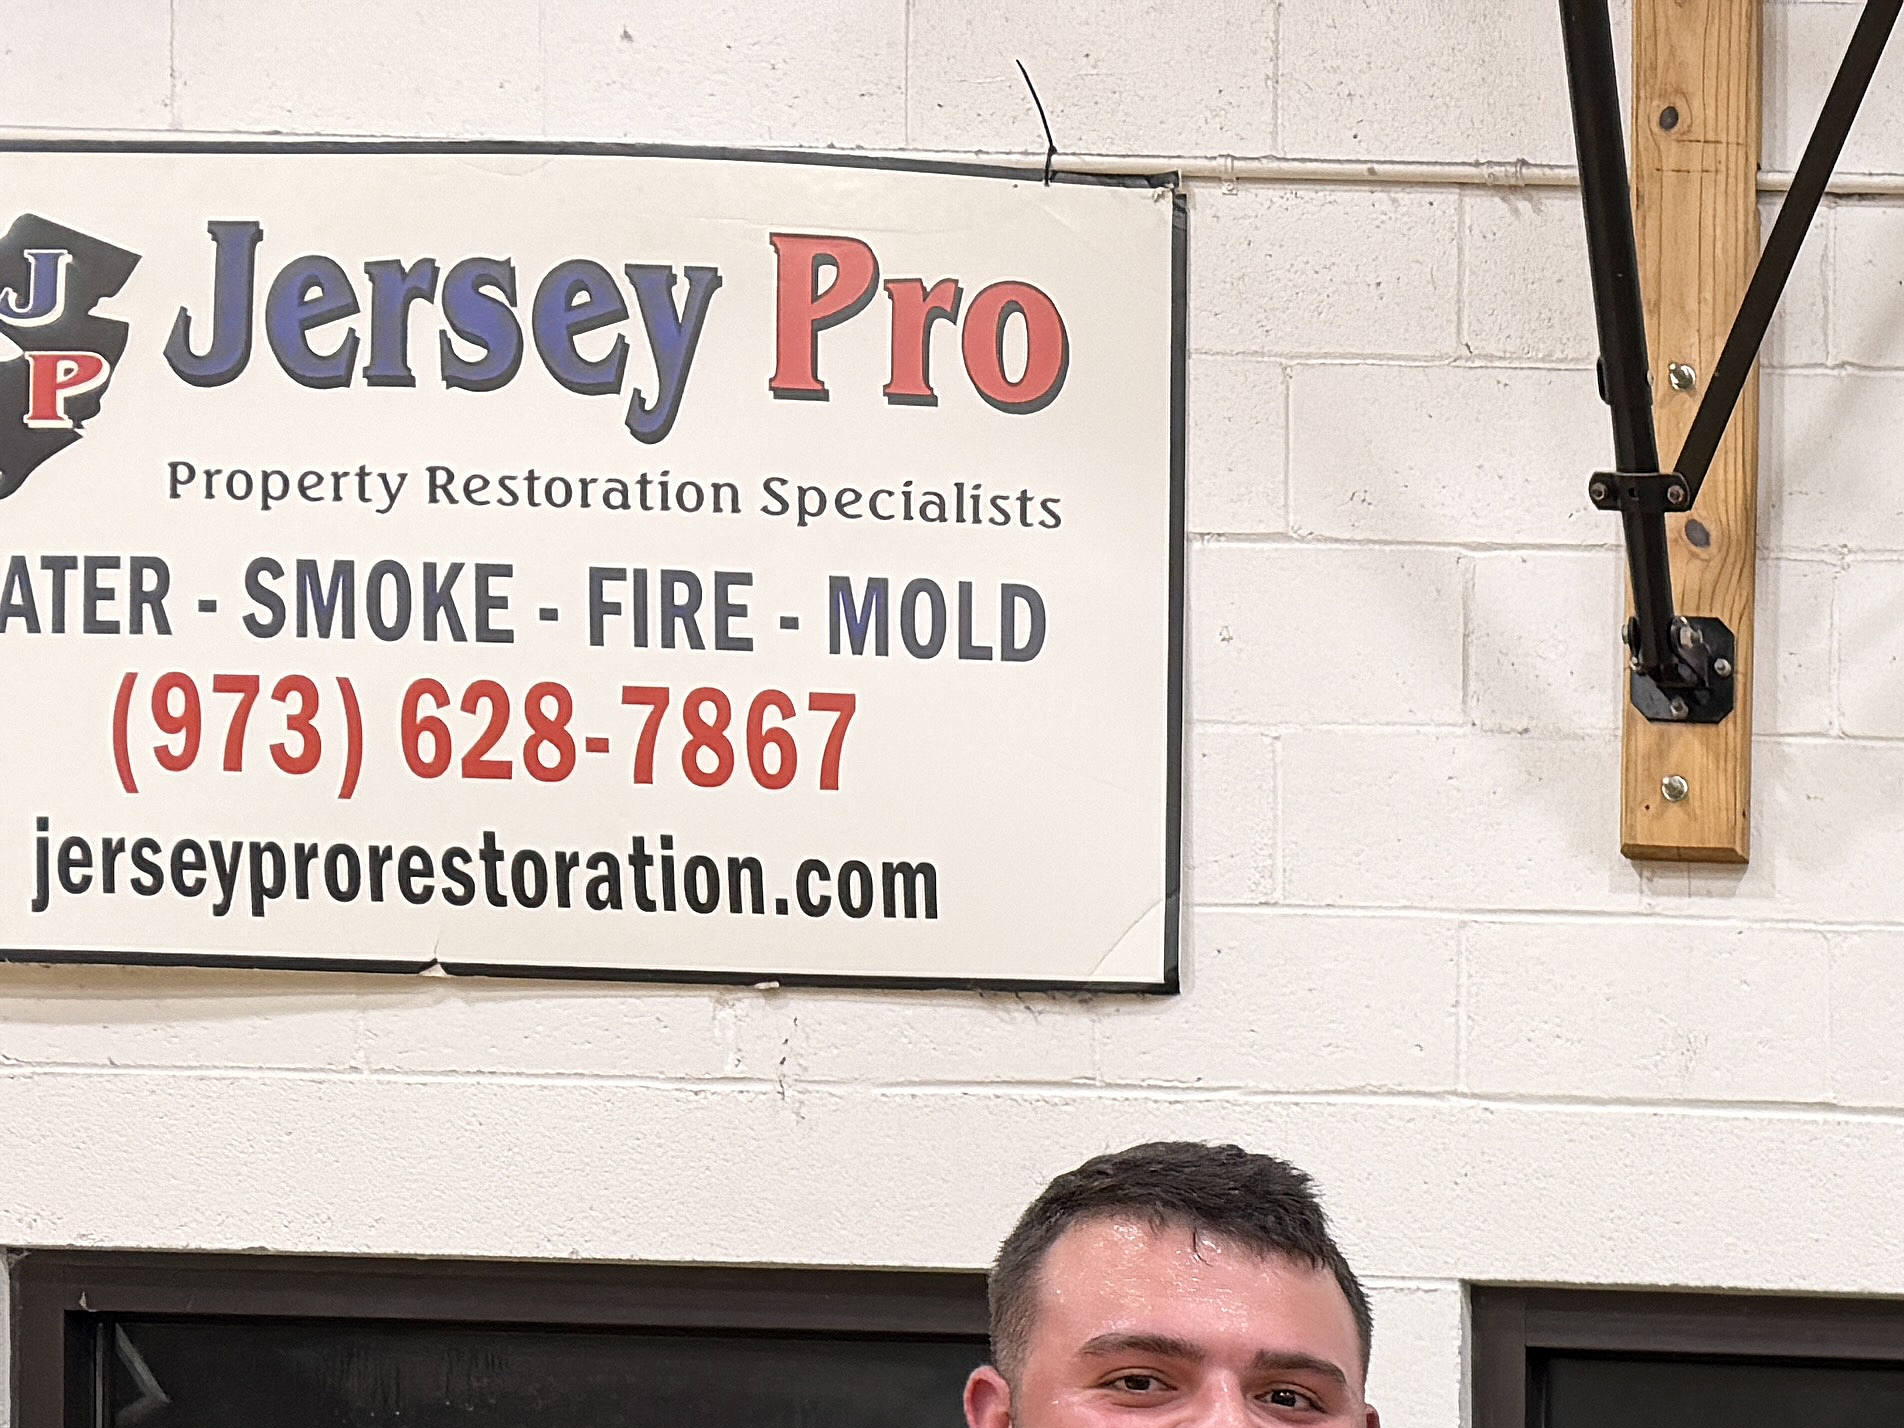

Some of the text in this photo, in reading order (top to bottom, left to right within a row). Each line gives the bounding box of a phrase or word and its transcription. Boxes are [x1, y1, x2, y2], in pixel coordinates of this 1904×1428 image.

[163, 221, 1069, 444] Jersey Pro
[24, 351, 110, 428] P
[168, 462, 1063, 531] Property Restoration Specialists
[0, 556, 172, 635] ATER
[243, 557, 514, 643] SMOKE
[589, 567, 753, 651] FIRE
[829, 576, 1046, 662] MOLD
[113, 672, 858, 799] (973) 628-7867
[32, 817, 939, 919] jerseyprorestoration.com
